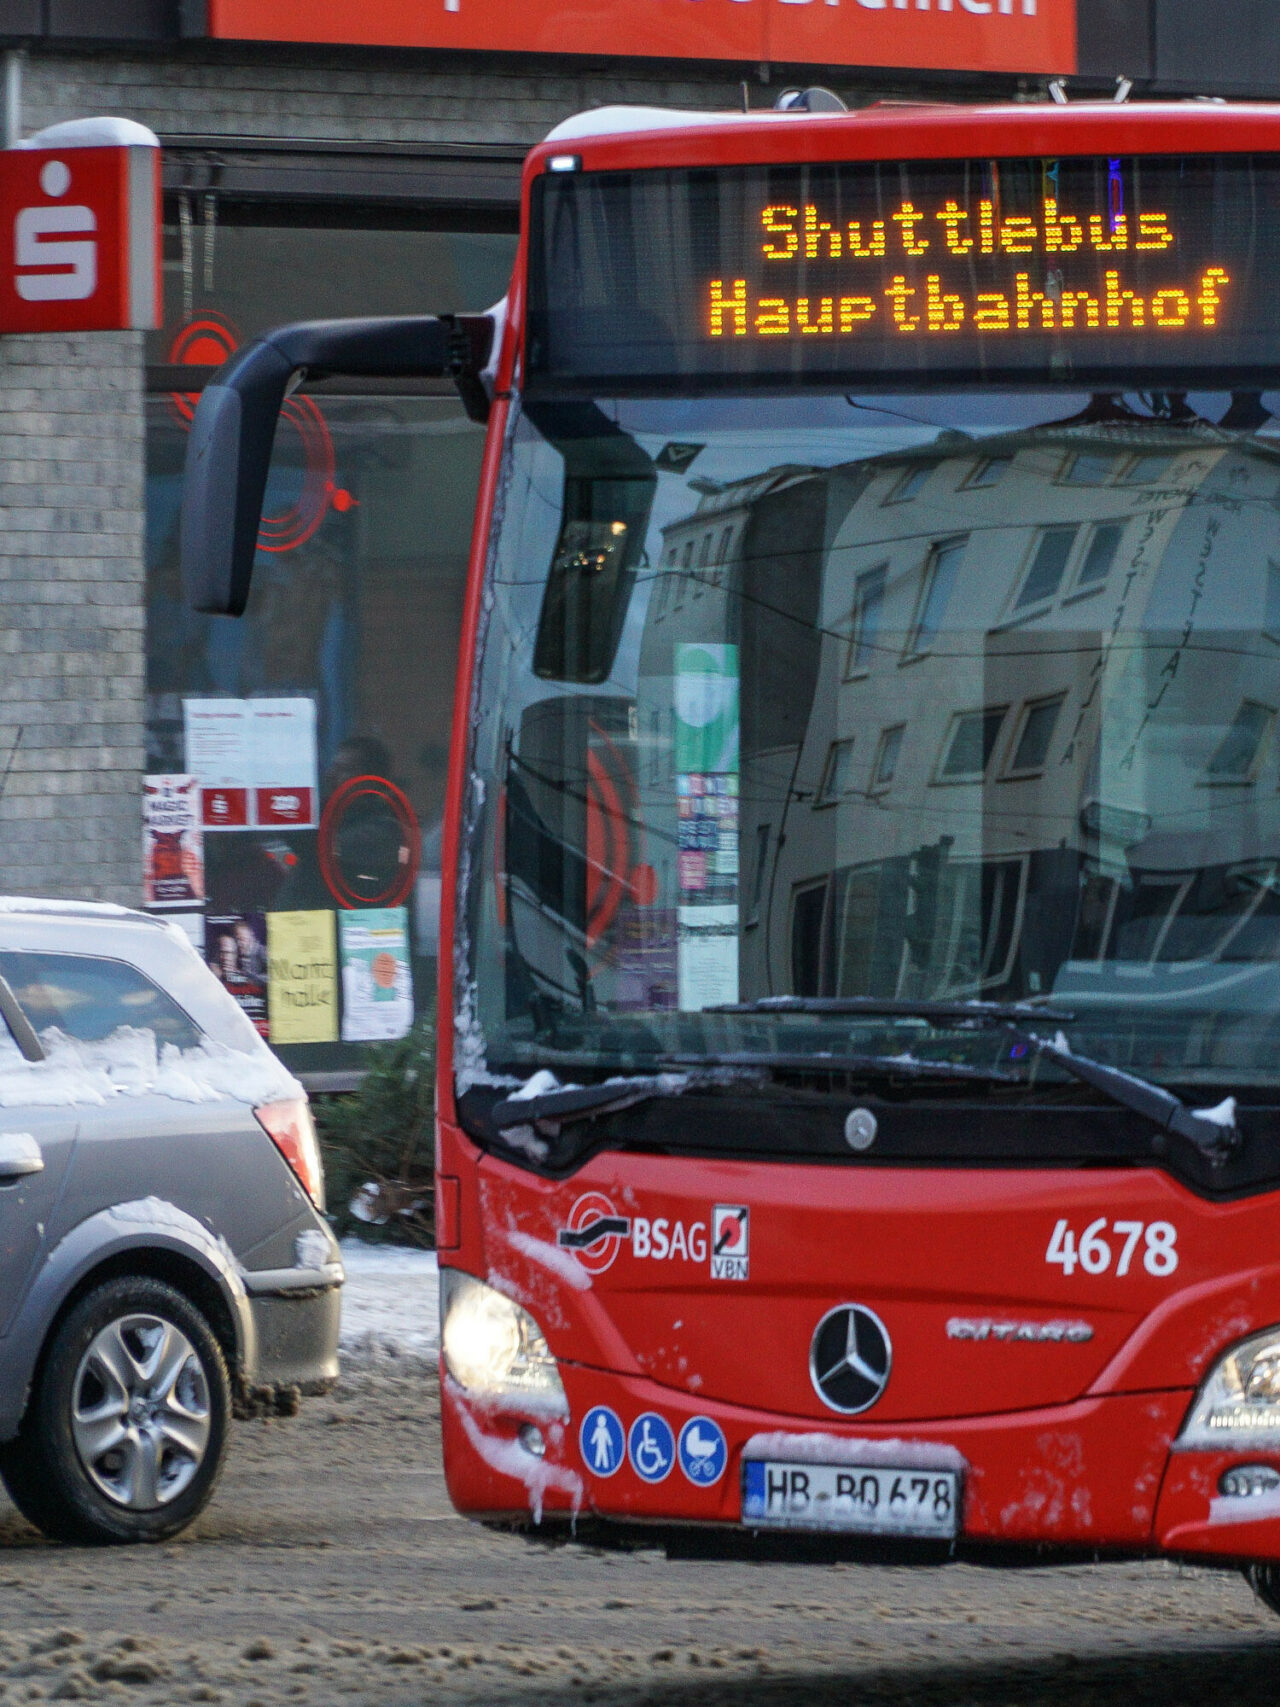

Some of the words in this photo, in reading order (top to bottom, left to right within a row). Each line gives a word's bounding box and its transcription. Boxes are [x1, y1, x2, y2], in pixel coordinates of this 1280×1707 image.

[762, 199, 1172, 258] Shuttlebus
[710, 268, 1228, 335] Hauptbahnhof
[633, 1217, 707, 1263] BSAG
[1045, 1217, 1179, 1277] 4678
[713, 1258, 748, 1279] VBN
[889, 1477, 951, 1521] 678
